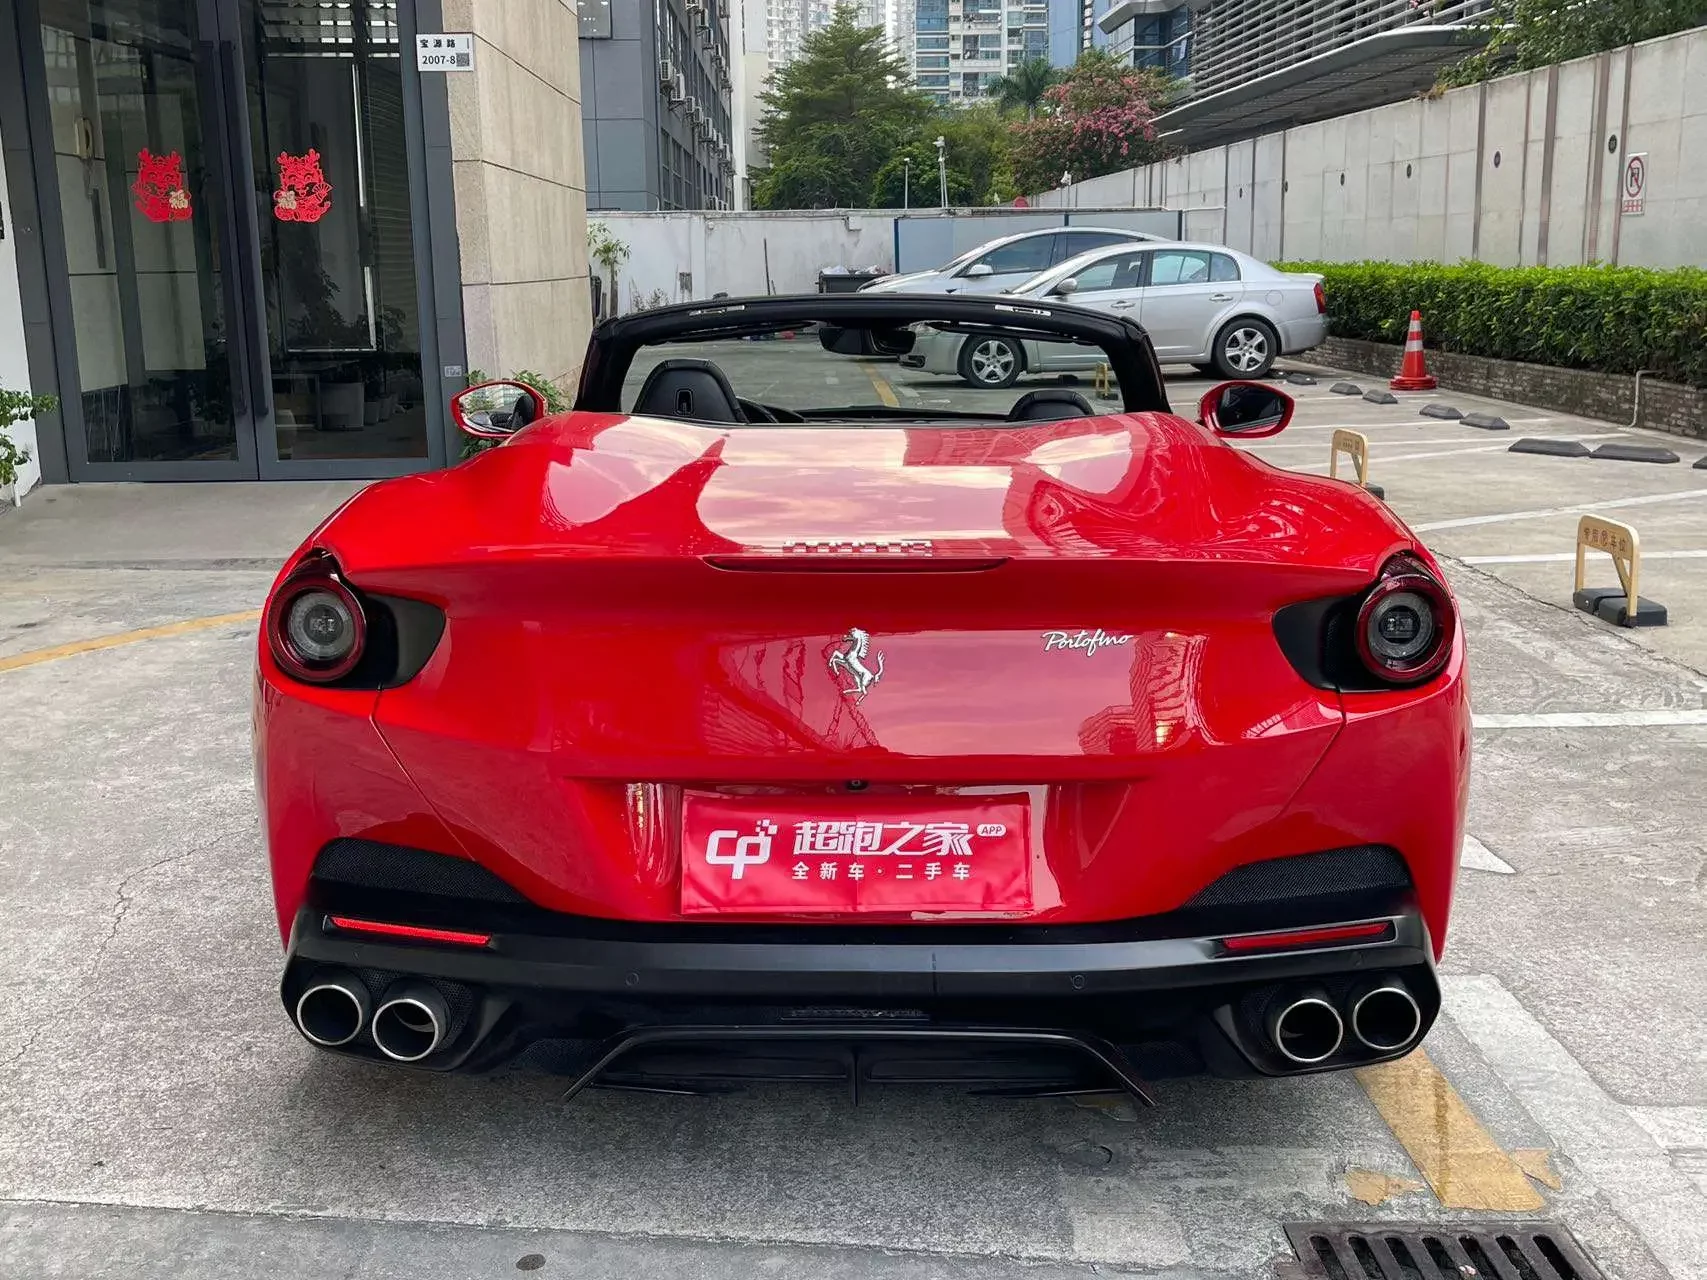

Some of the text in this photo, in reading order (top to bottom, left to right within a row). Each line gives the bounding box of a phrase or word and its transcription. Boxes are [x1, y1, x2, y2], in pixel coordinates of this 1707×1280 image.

[420, 38, 456, 48] 宝源路
[422, 55, 456, 65] 2007-8
[1042, 629, 1134, 657] Portofino
[793, 821, 1004, 856] 超跑之家 APP
